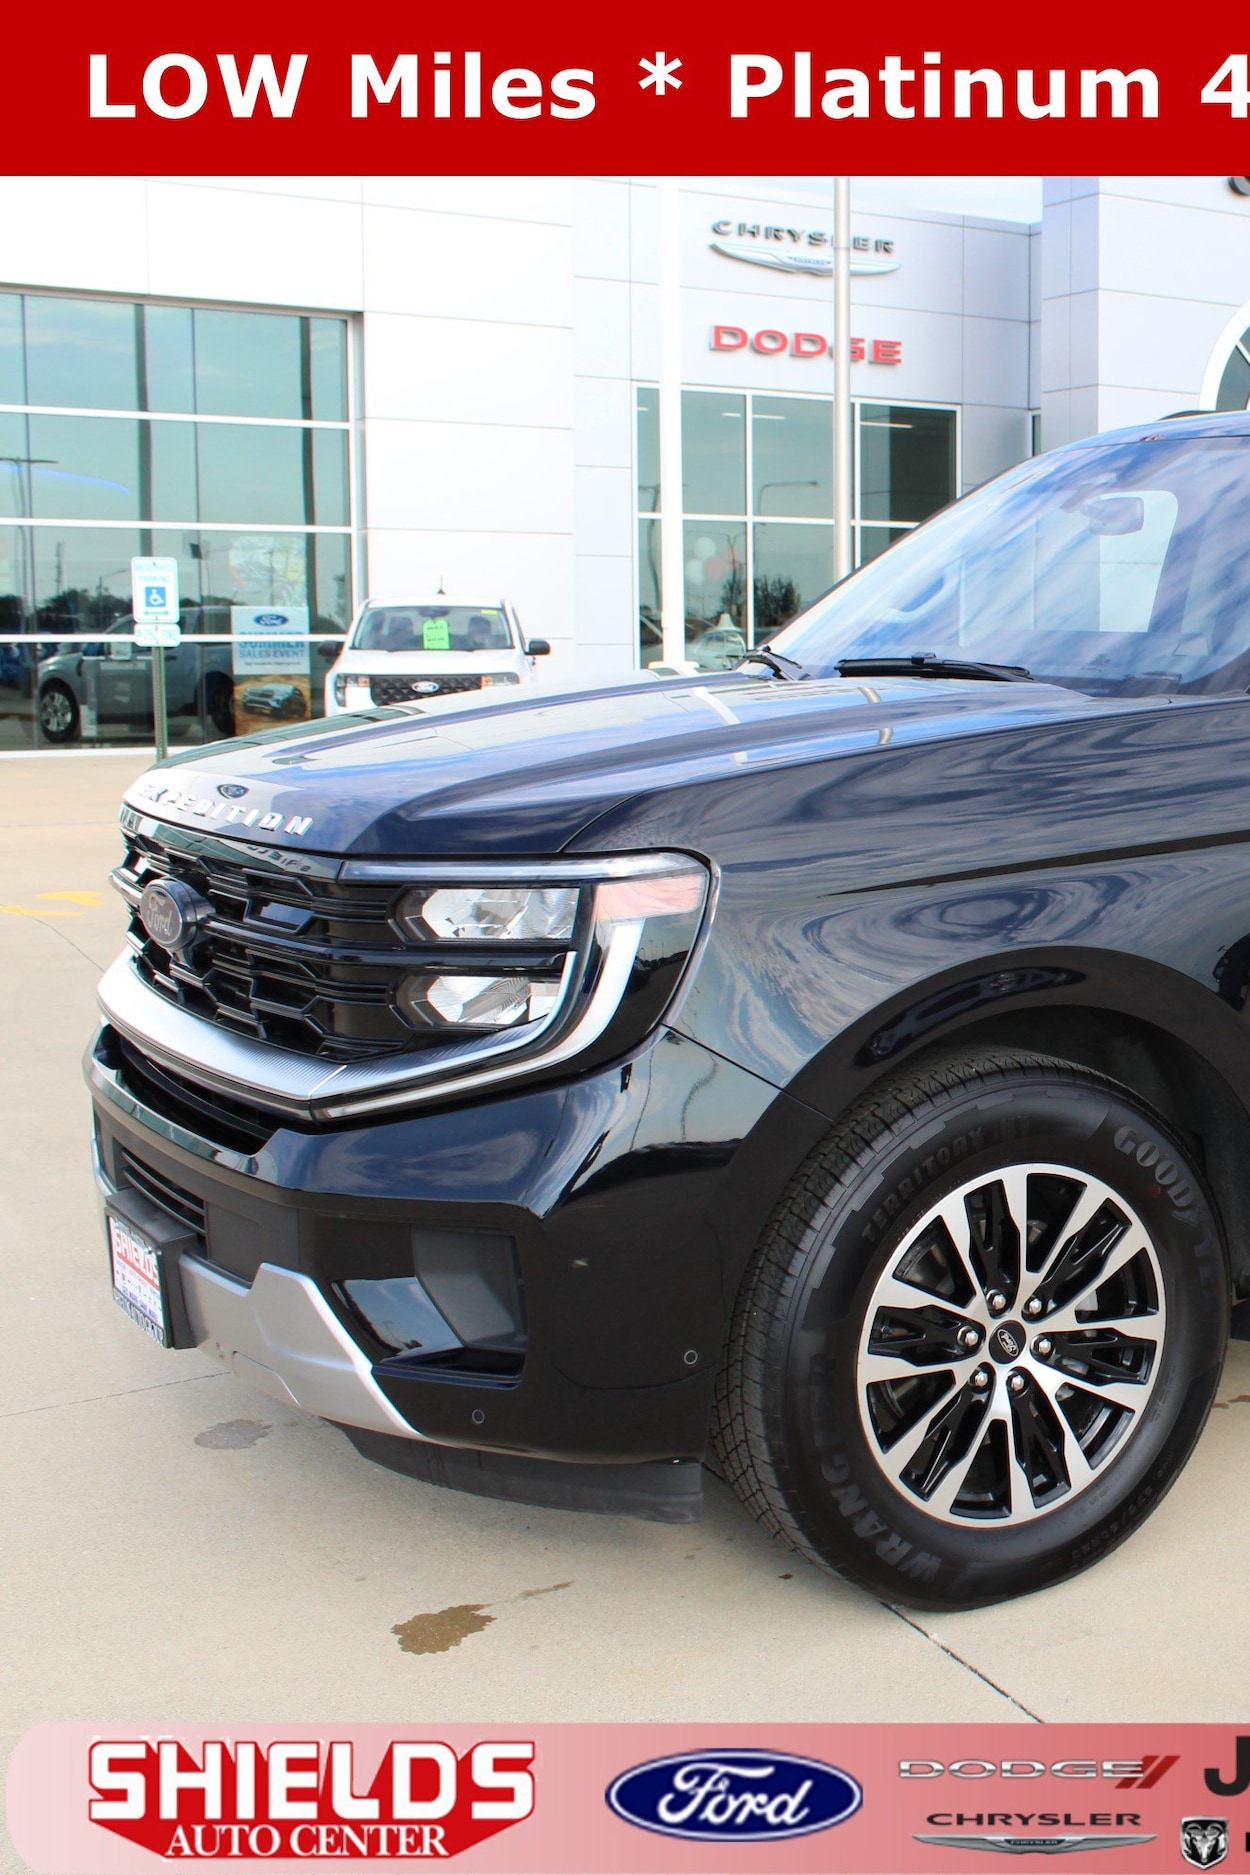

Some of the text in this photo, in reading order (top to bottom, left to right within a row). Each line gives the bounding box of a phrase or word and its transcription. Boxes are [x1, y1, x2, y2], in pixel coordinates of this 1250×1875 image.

[711, 220, 895, 253] CHRYSER
[239, 649, 305, 658] SALES EVENT
[861, 1126, 984, 1243] TERRITORY
